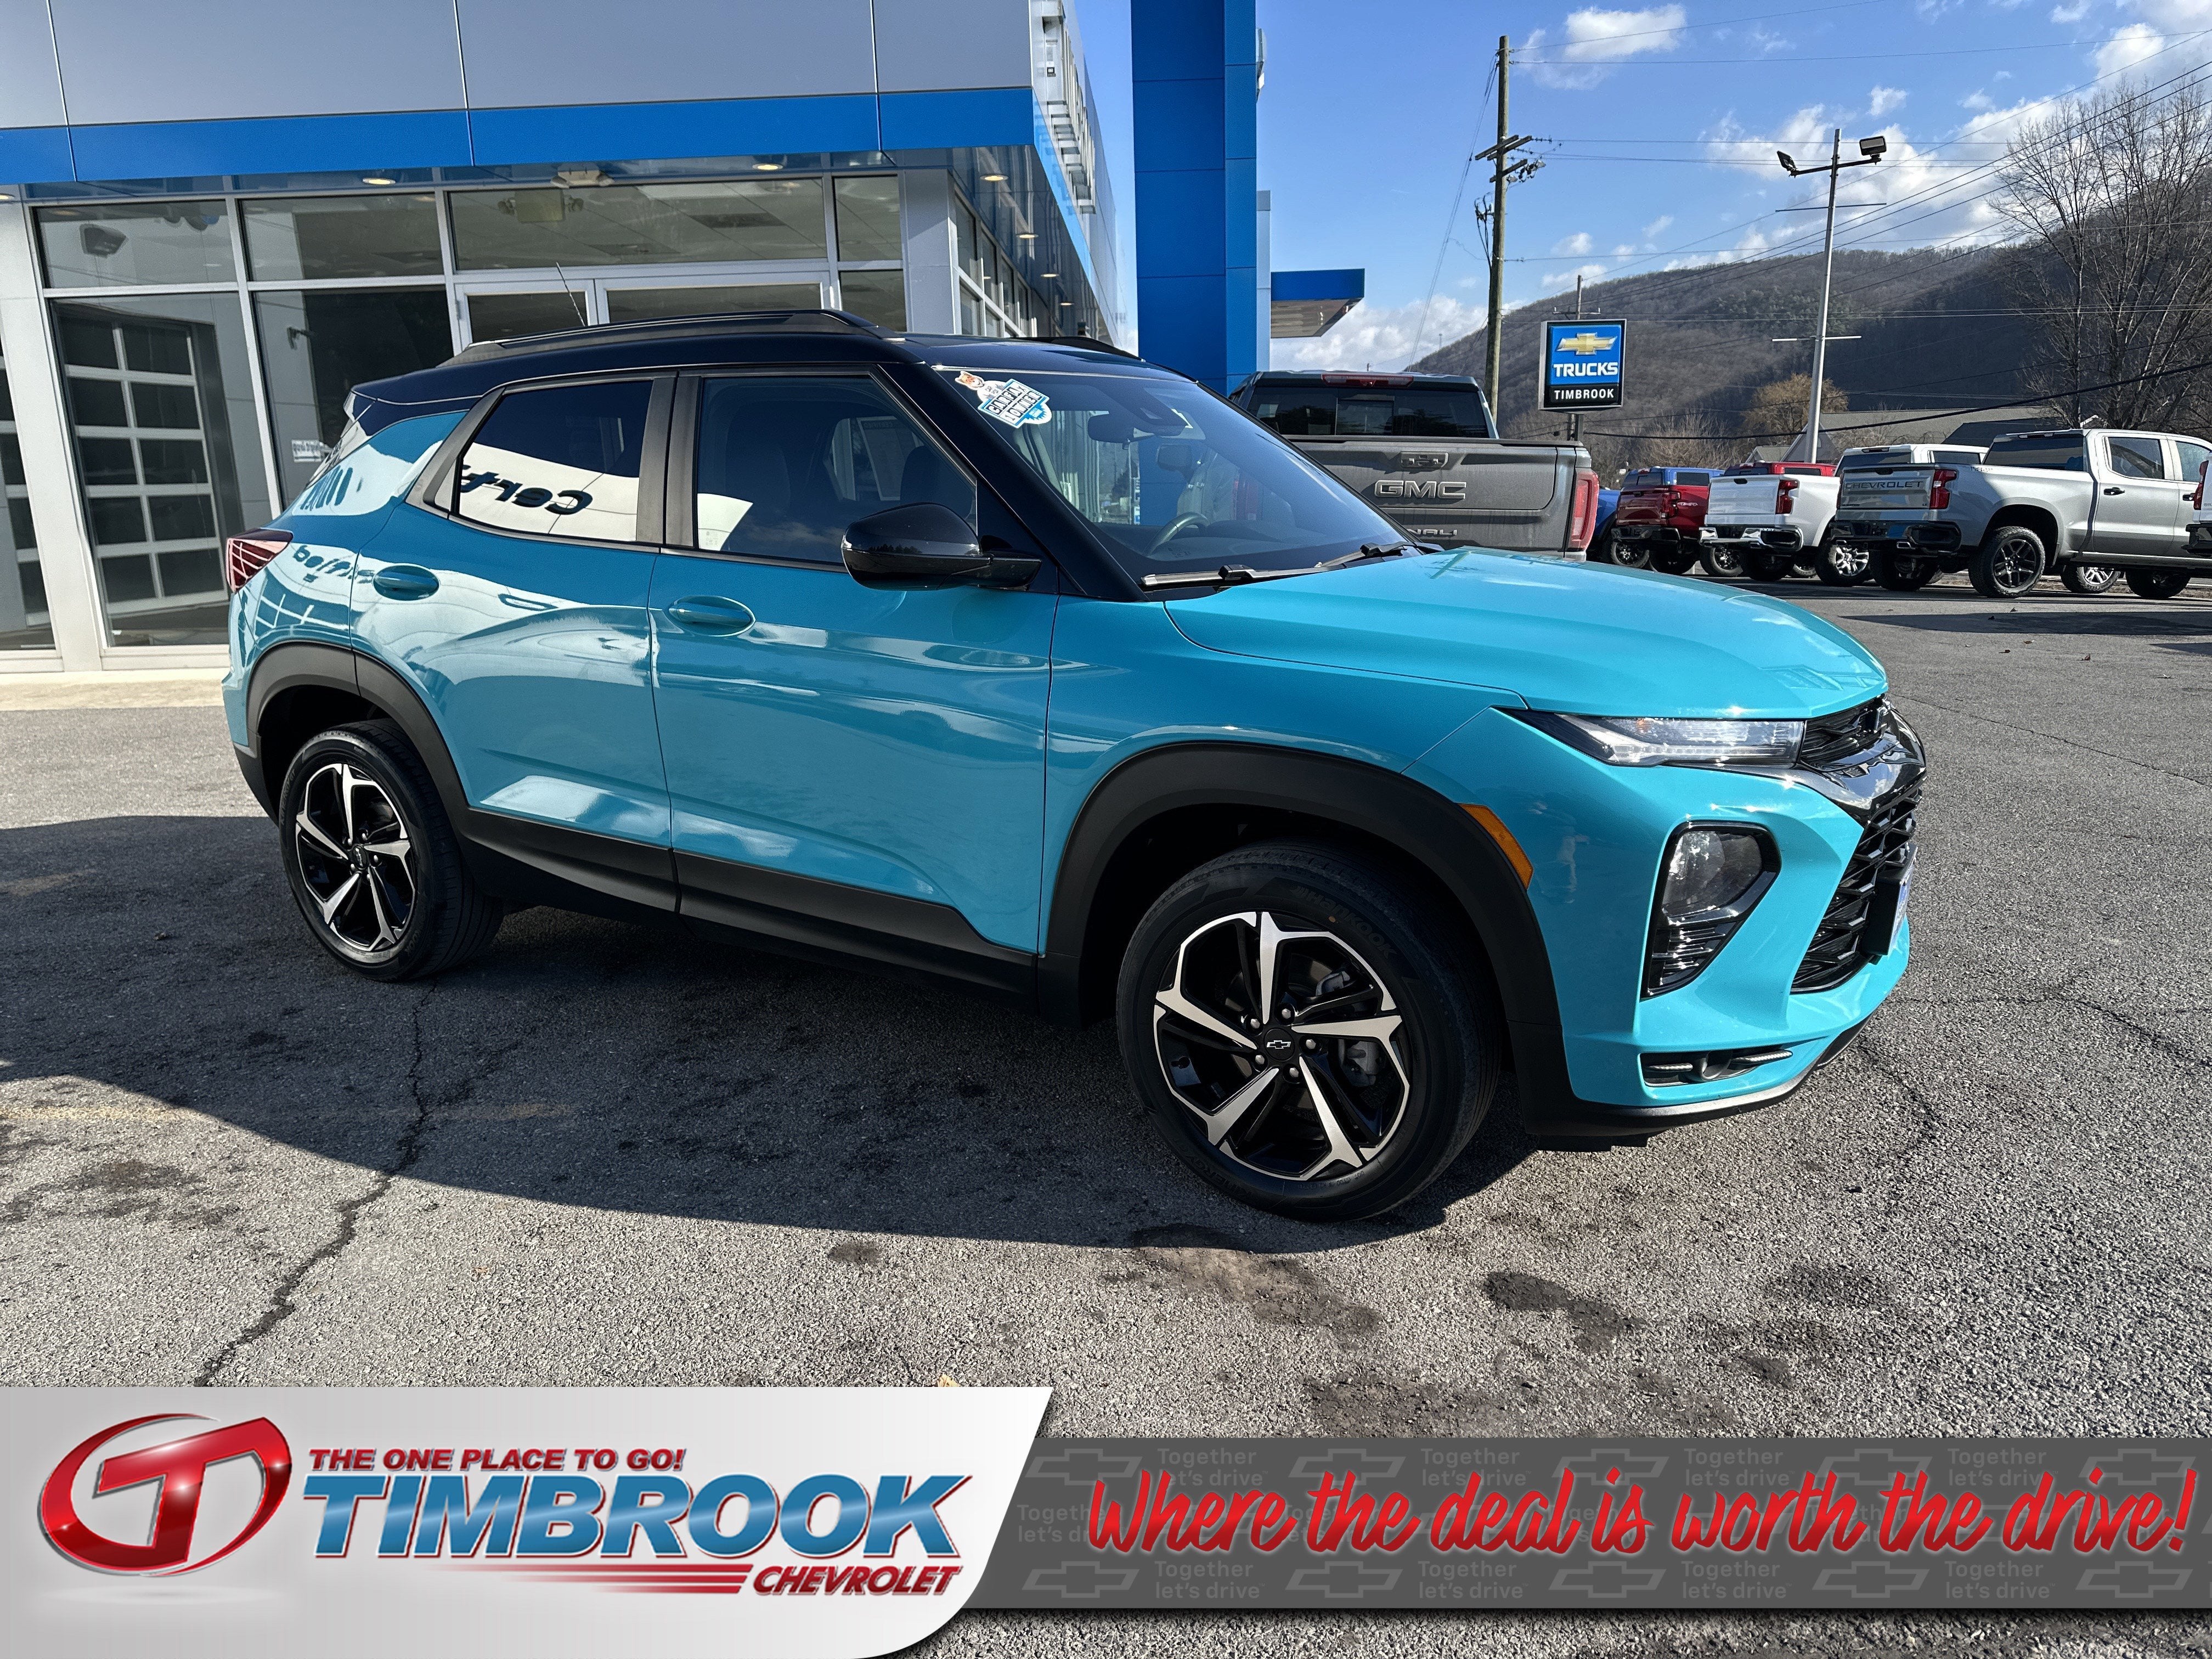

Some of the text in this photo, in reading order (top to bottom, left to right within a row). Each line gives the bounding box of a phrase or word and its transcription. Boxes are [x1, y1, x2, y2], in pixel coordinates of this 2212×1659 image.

[1553, 362, 1618, 377] TRUCKS
[987, 385, 1028, 416] CARFAX
[1554, 388, 1615, 400] TIMBROOK
[1007, 390, 1043, 419] OWNER
[1374, 479, 1466, 500] GMC
[1845, 481, 1924, 489] CHEVROLET
